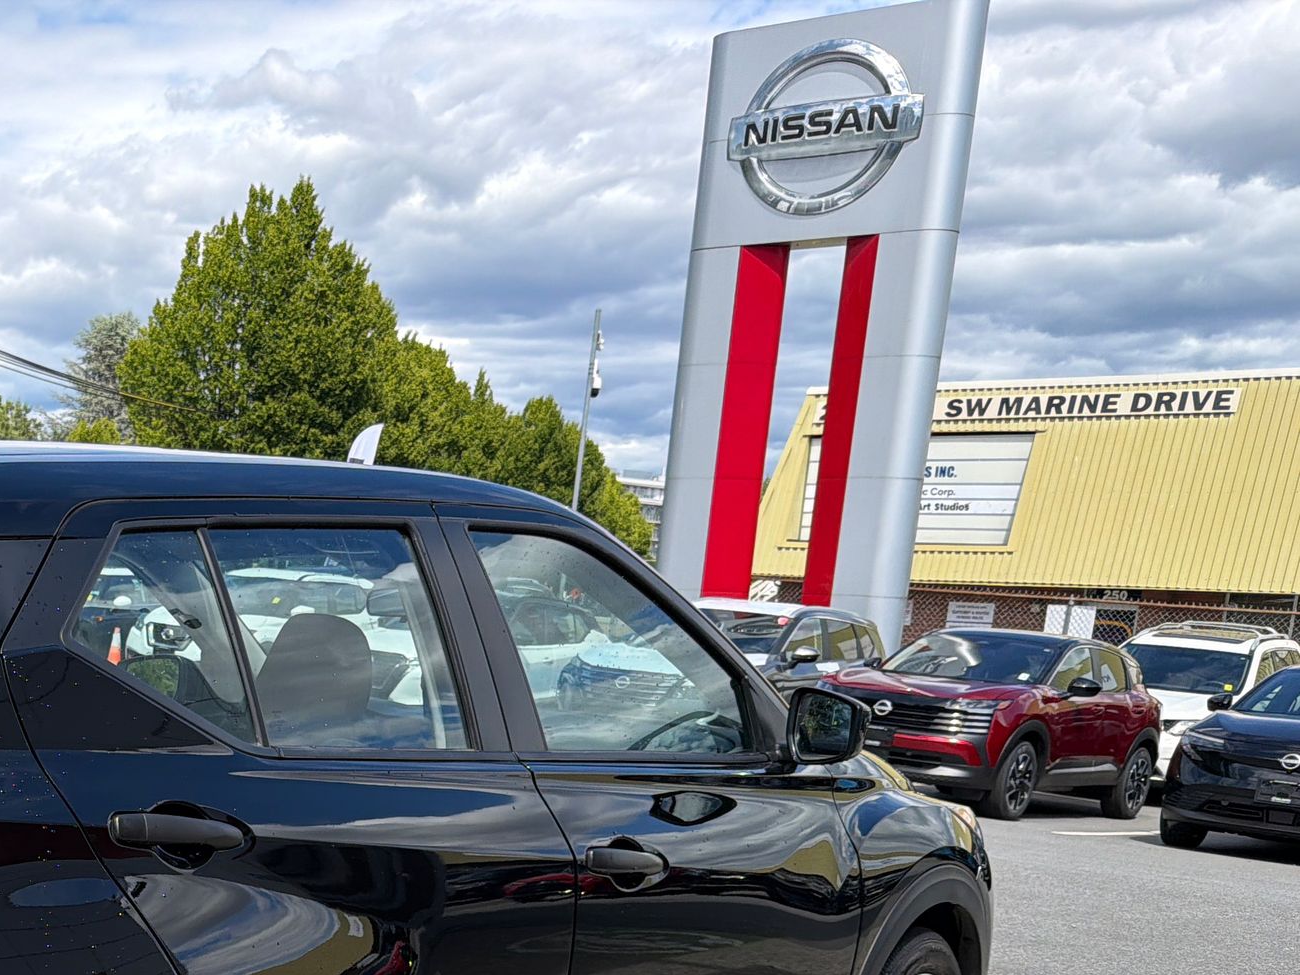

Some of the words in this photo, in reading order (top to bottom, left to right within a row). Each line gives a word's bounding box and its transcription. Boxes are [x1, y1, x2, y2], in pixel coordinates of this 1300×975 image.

[743, 103, 901, 147] NISSAN
[945, 399, 993, 417] SW
[997, 393, 1121, 416] MARINE
[1129, 390, 1235, 411] DRIVE
[935, 466, 957, 478] INC.
[930, 487, 956, 497] Corp.
[934, 502, 970, 512] Studios
[1102, 589, 1129, 600] 250
